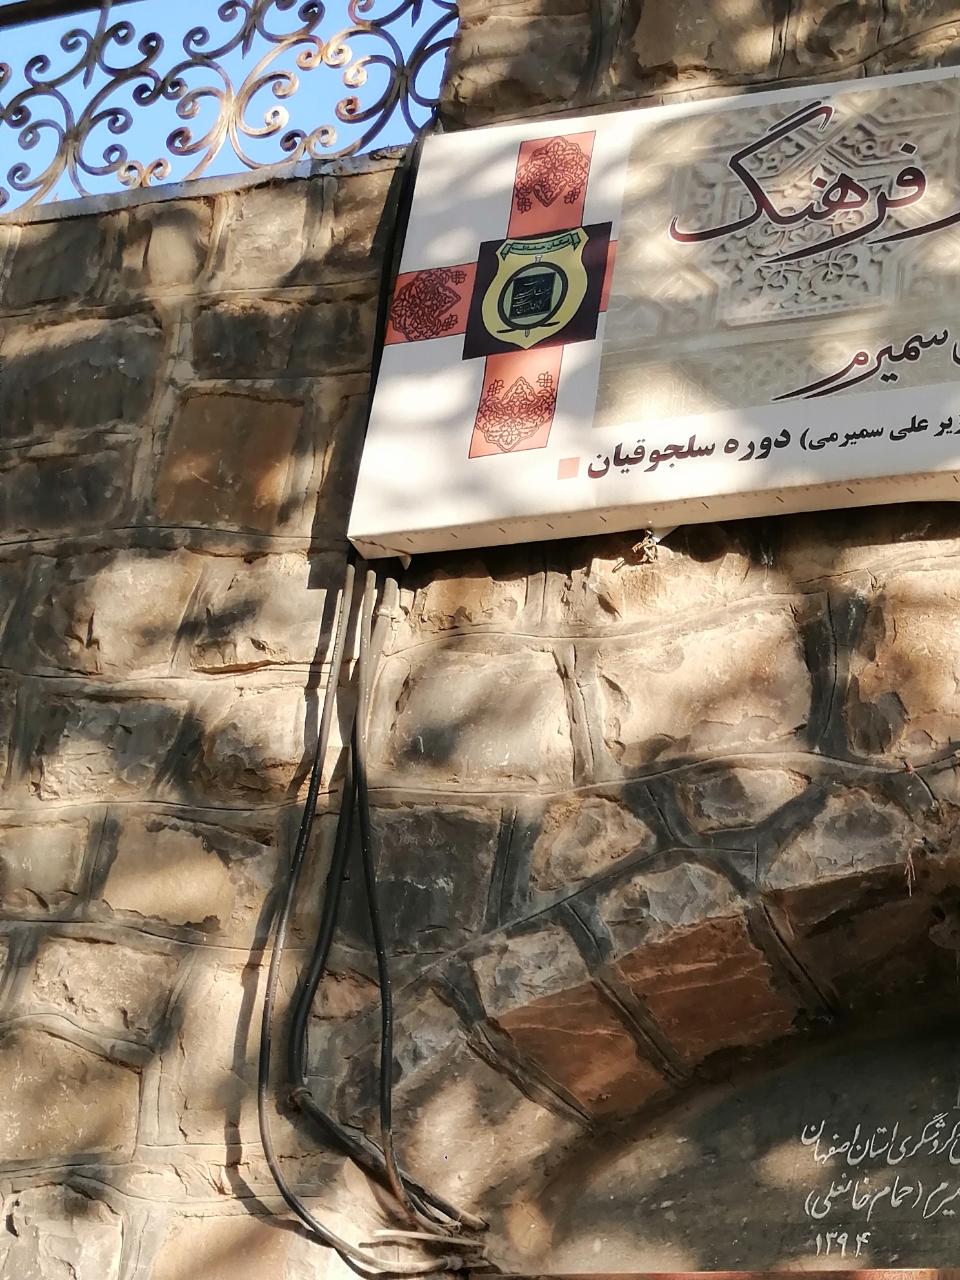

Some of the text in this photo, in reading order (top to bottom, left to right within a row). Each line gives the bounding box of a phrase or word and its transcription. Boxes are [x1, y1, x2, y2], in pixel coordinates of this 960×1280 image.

[669, 100, 928, 265] فرهنگ
[771, 325, 949, 402] سمیرم
[723, 428, 791, 462] دوره
[889, 415, 929, 441] علی
[587, 434, 716, 479] سلجوقیان
[801, 1119, 861, 1165] اصفهان
[846, 1121, 900, 1166] استان
[815, 1231, 871, 1258] ۱۳۹۴
